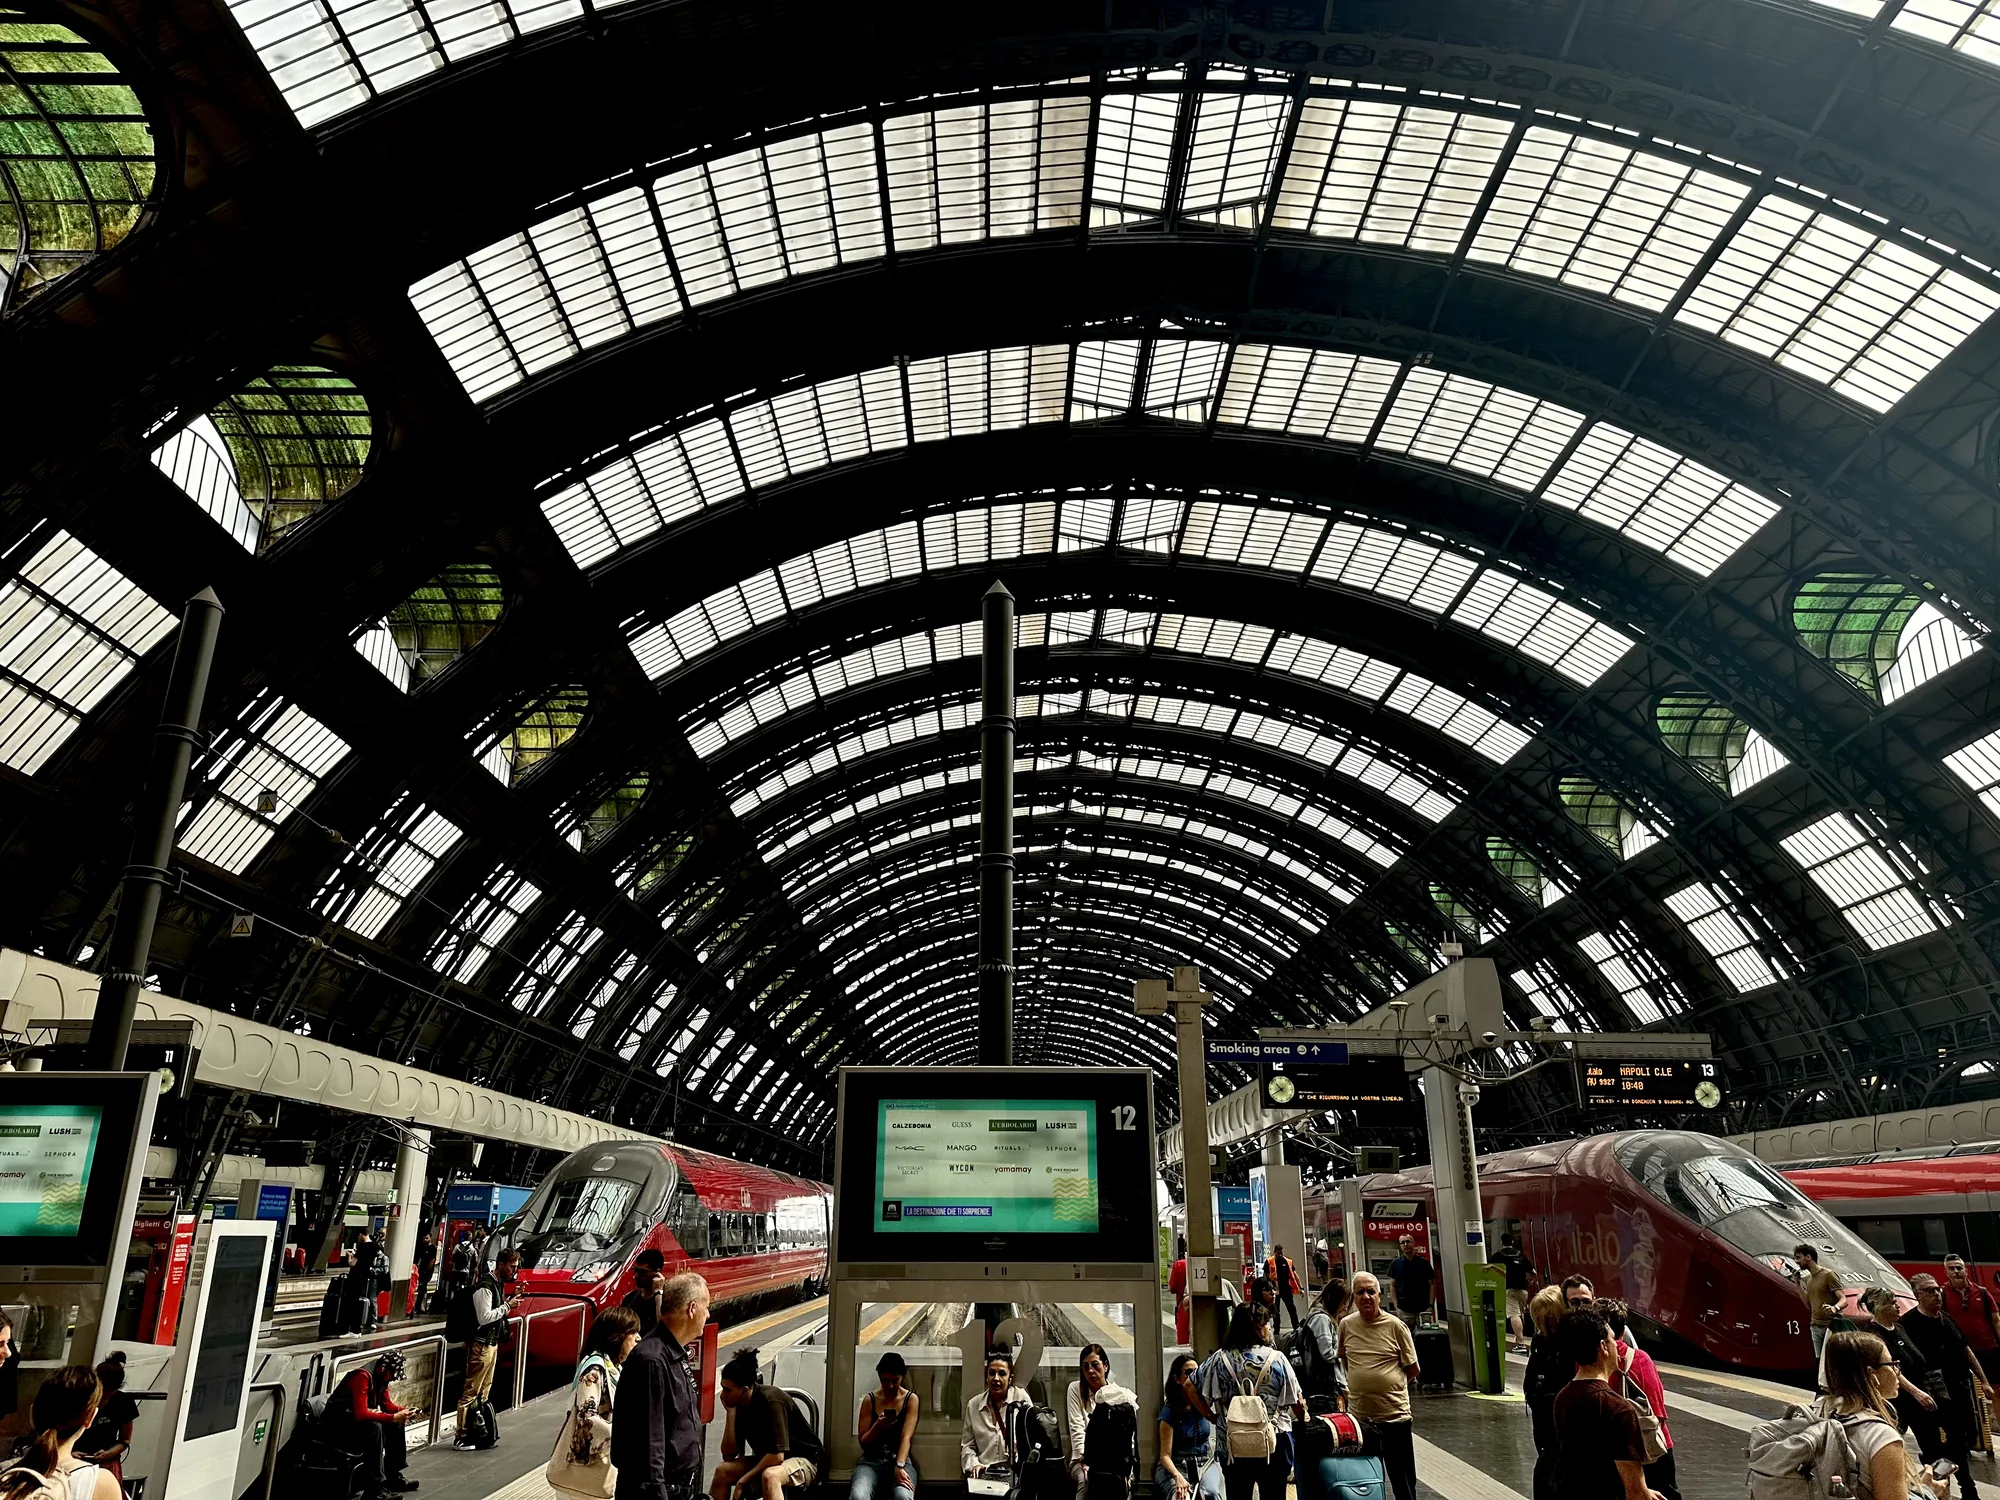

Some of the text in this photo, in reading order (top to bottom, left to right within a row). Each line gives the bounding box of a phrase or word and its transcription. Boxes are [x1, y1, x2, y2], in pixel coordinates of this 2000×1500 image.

[1209, 1043, 1290, 1056] Smoking area
[164, 1050, 174, 1063] 11
[1620, 1067, 1673, 1077] NAPOLI C.LE
[1701, 1064, 1715, 1077] 13
[1586, 1077, 1597, 1087] AV
[1621, 1081, 1644, 1091] 10:40
[1111, 1105, 1136, 1131] 12
[906, 1207, 913, 1216] LA
[914, 1207, 946, 1216] DESTINAZIONE
[947, 1207, 957, 1216] CHE
[957, 1207, 962, 1216] TI
[962, 1207, 991, 1216] SORPRENDE.
[134, 1220, 160, 1228] Biglietti
[538, 1256, 567, 1266] ntv
[1194, 1268, 1206, 1279] 12
[1842, 1272, 1874, 1284] ntv
[1786, 1320, 1800, 1336] 13
[947, 1318, 1044, 1398] 12
